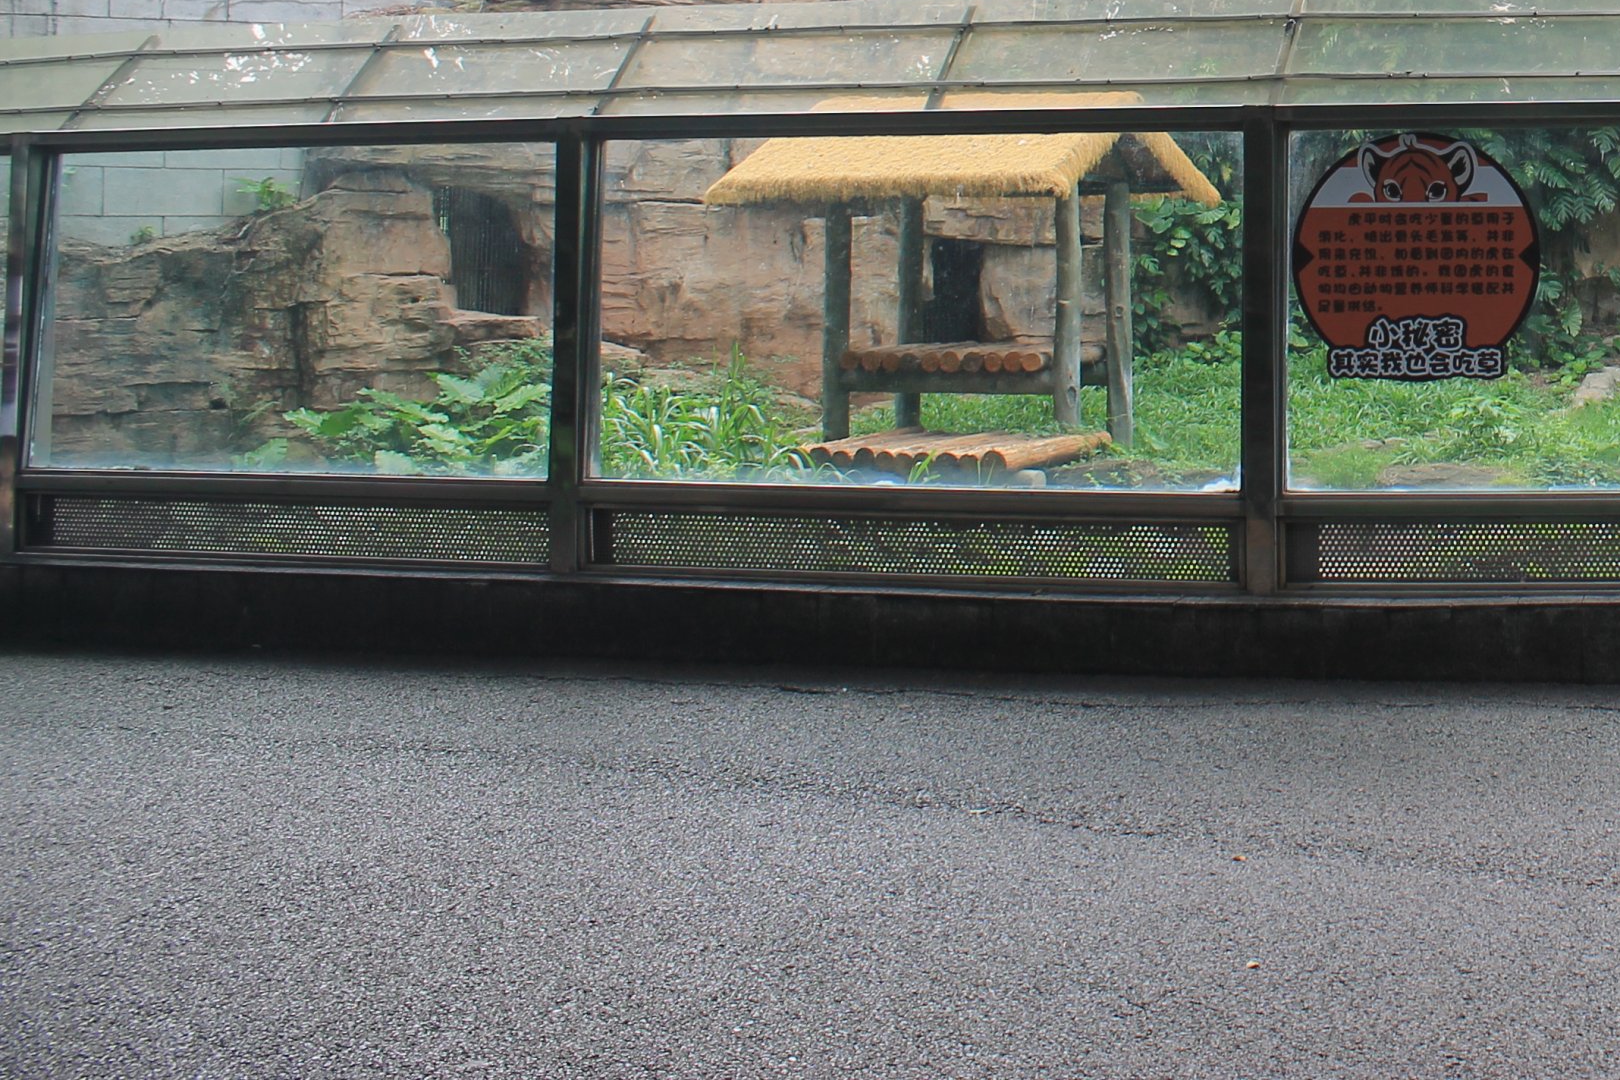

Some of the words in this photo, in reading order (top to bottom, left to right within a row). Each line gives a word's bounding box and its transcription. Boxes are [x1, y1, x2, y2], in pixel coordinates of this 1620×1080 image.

[1368, 317, 1464, 350] 小秘密
[1330, 348, 1502, 376] 其实我也会吃草
